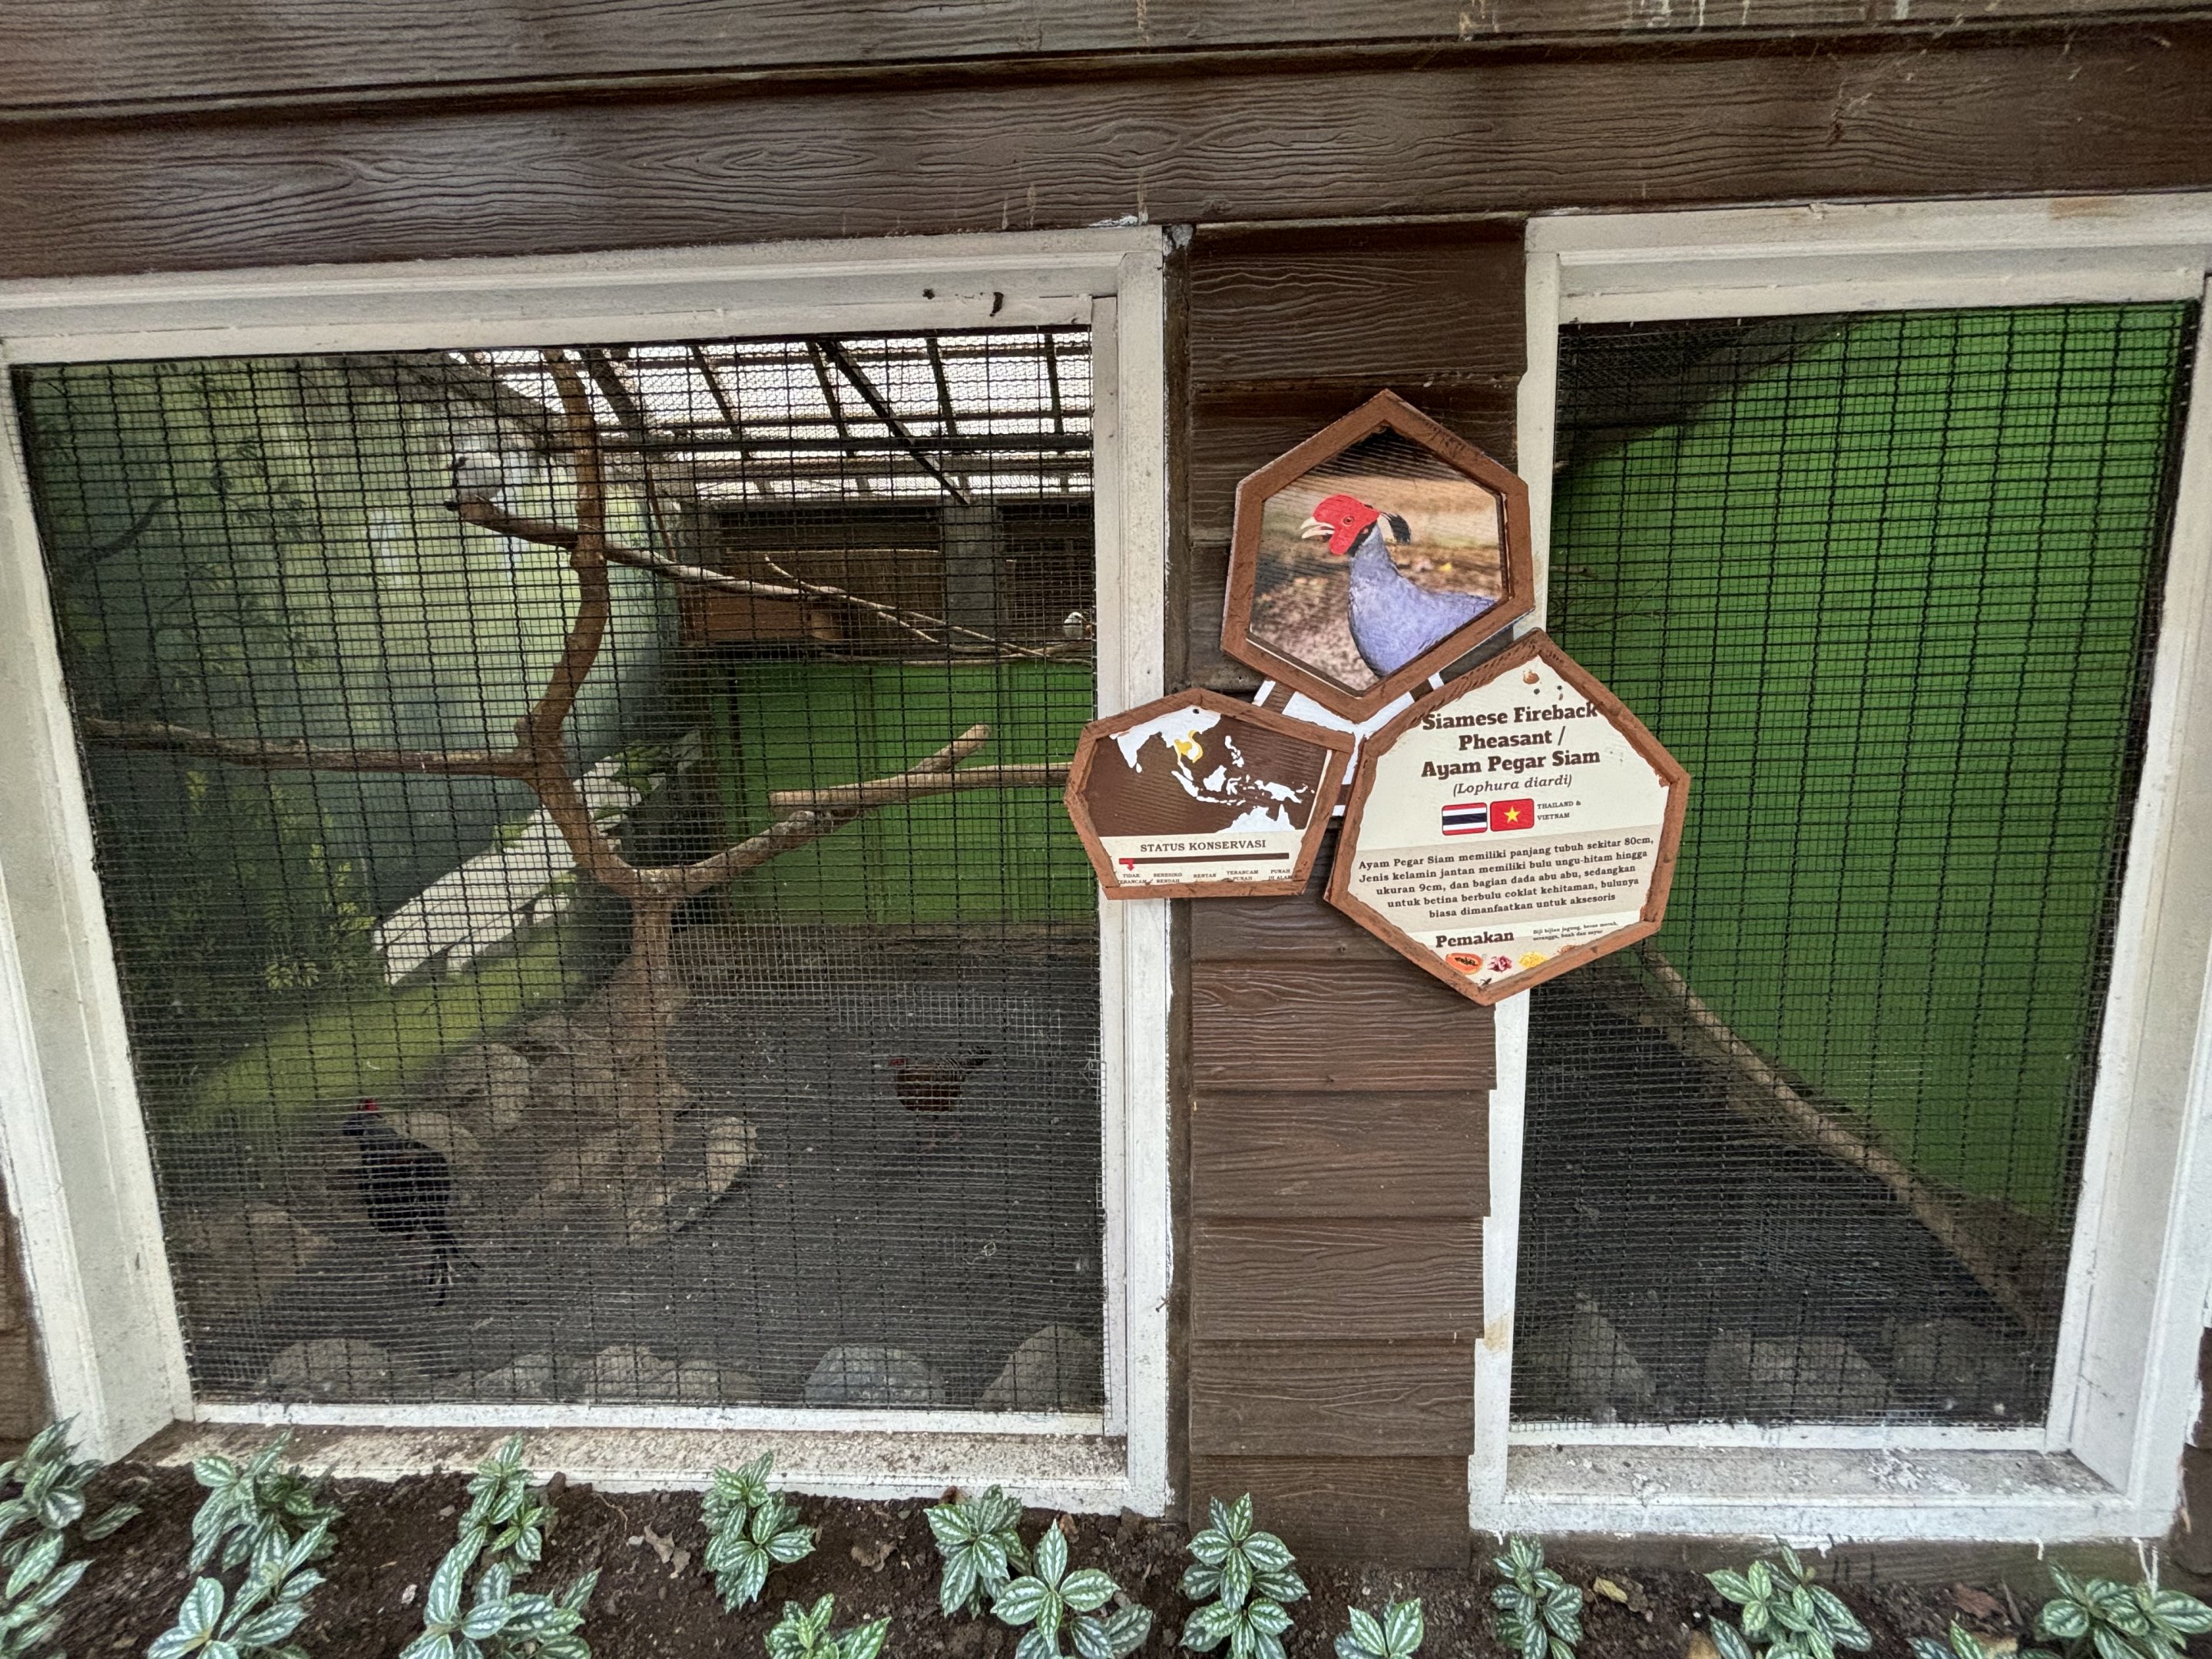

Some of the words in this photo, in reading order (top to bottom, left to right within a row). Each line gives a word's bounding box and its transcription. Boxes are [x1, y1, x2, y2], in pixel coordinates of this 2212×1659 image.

[1422, 712, 1508, 730] Siamese
[1514, 702, 1598, 723] Fireback
[1459, 730, 1552, 750] Pheasant
[1557, 726, 1566, 746] /
[1421, 760, 1482, 780] Ayam
[1488, 754, 1546, 774] Pegar
[1551, 750, 1601, 767] Siam
[1453, 781, 1518, 797] (Lophura
[1524, 774, 1572, 789] diardi)
[1537, 801, 1574, 810] THAILAND
[1140, 843, 1185, 853] STATUS
[1190, 839, 1267, 851] KONSERVASI
[1359, 861, 1390, 870] Ayam
[1393, 858, 1425, 868] Pegar
[1427, 856, 1455, 864] Siam
[1459, 849, 1506, 862] memiliki
[1510, 846, 1551, 859] panjang
[1554, 843, 1584, 853] tubuh
[1587, 839, 1621, 849] sekitar
[1624, 836, 1654, 846] 80cm,
[1359, 874, 1389, 882] Jenis
[1392, 870, 1436, 881] kelamin
[1439, 867, 1475, 879] jantan
[1479, 861, 1526, 873] memiliki
[1529, 859, 1552, 869] bulu
[1555, 854, 1613, 867] ungu-hitam
[1616, 849, 1647, 860] hingga
[1376, 886, 1416, 895] ukuran
[1419, 883, 1446, 892] 9cm,
[1450, 881, 1469, 889] dan
[1472, 879, 1507, 889] bagian
[1511, 875, 1535, 883] dada
[1538, 873, 1557, 881] abu
[1560, 870, 1581, 879] abu,
[1584, 865, 1635, 877] sedangkan
[1387, 898, 1421, 908] untuk
[1424, 895, 1458, 905] betina
[1461, 892, 1502, 902] berbulu
[1505, 888, 1538, 898] coklat
[1541, 882, 1598, 895] kehitaman,
[1601, 878, 1639, 889] bulunya
[1461, 902, 1533, 916] dimanfaatkan
[1536, 898, 1567, 908] untuk
[1570, 893, 1616, 904] aksesoris
[1435, 931, 1515, 949] Pemakan
